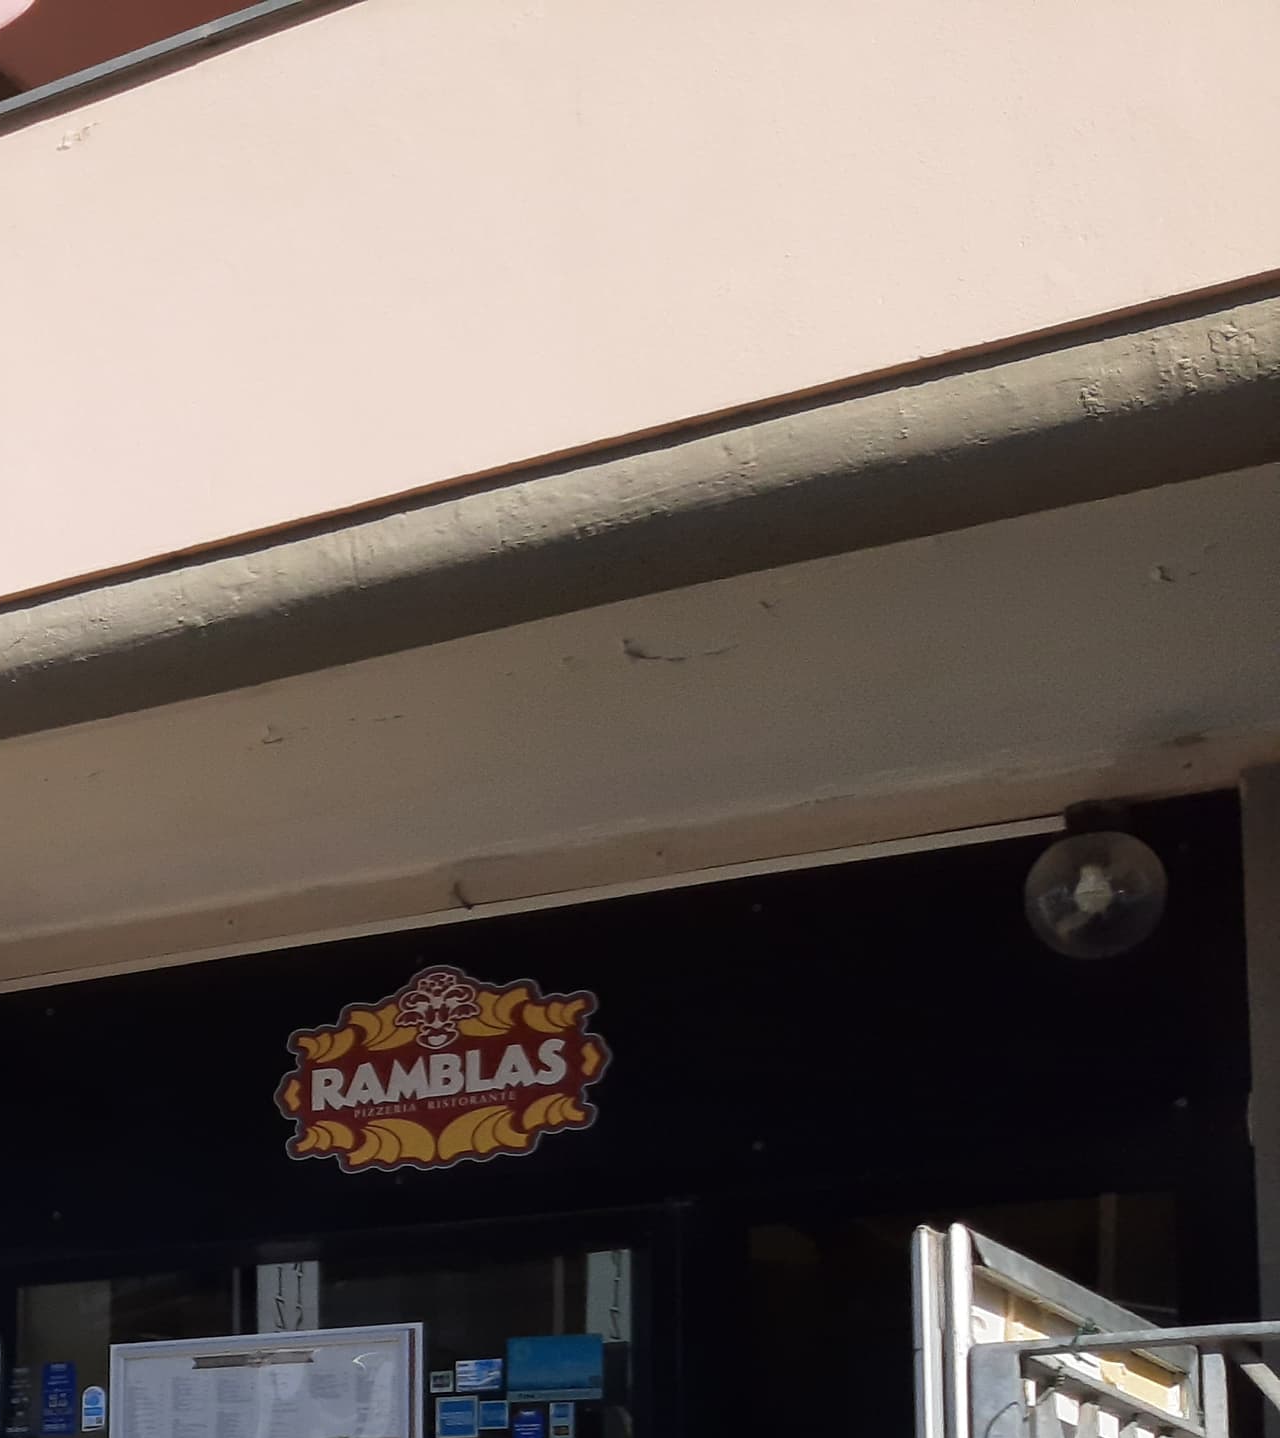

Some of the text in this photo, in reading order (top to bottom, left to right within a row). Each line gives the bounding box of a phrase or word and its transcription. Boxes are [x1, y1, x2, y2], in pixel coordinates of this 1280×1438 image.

[311, 1039, 567, 1112] RAMBLAS
[353, 1091, 517, 1119] PIZZERIA RISTORANTE
